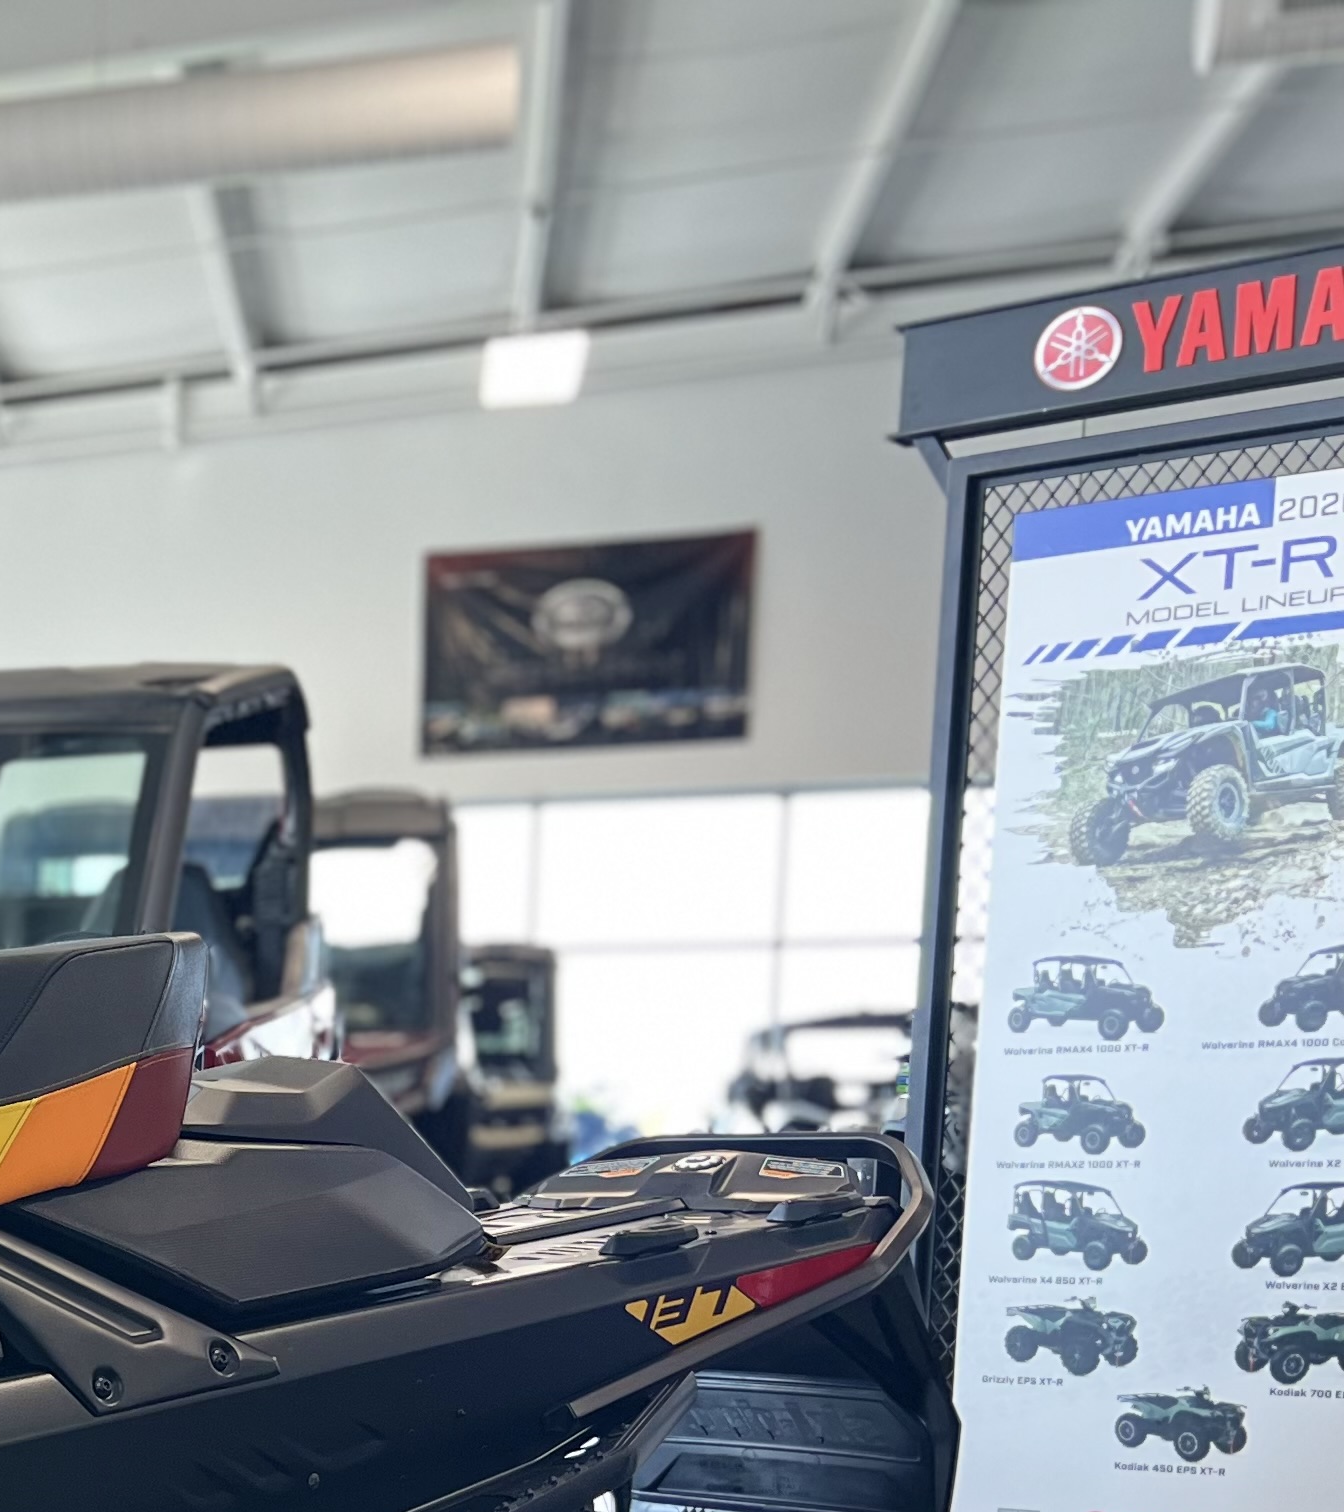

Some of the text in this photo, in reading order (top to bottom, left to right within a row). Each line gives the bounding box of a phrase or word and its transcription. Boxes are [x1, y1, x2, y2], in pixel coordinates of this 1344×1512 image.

[1278, 492, 1344, 522] 202
[1126, 502, 1261, 543] YAMAHA
[1136, 535, 1338, 601] XT-R
[1126, 601, 1229, 627] MODEL
[1004, 1043, 1150, 1056] Wolverine RMAX4 1000 XT-R
[1201, 1040, 1255, 1050] Wolverine
[1258, 1039, 1298, 1048] RMAX4
[1302, 1038, 1329, 1047] 1000
[996, 1160, 1141, 1169] Wolverine RMAX2 1000 XT-R
[1269, 1159, 1342, 1168] Wolverine X2
[988, 1275, 1103, 1285] Wolverine X4 850 XT-R
[1265, 1281, 1320, 1290] Wolverine
[1322, 1282, 1338, 1291] X2
[982, 1375, 1064, 1386] Grizzly EPS XT-R
[1269, 1388, 1307, 1397] Kodiak
[1310, 1389, 1332, 1398] 700
[1114, 1461, 1226, 1477] Kodiak 450 EPS XT-R
